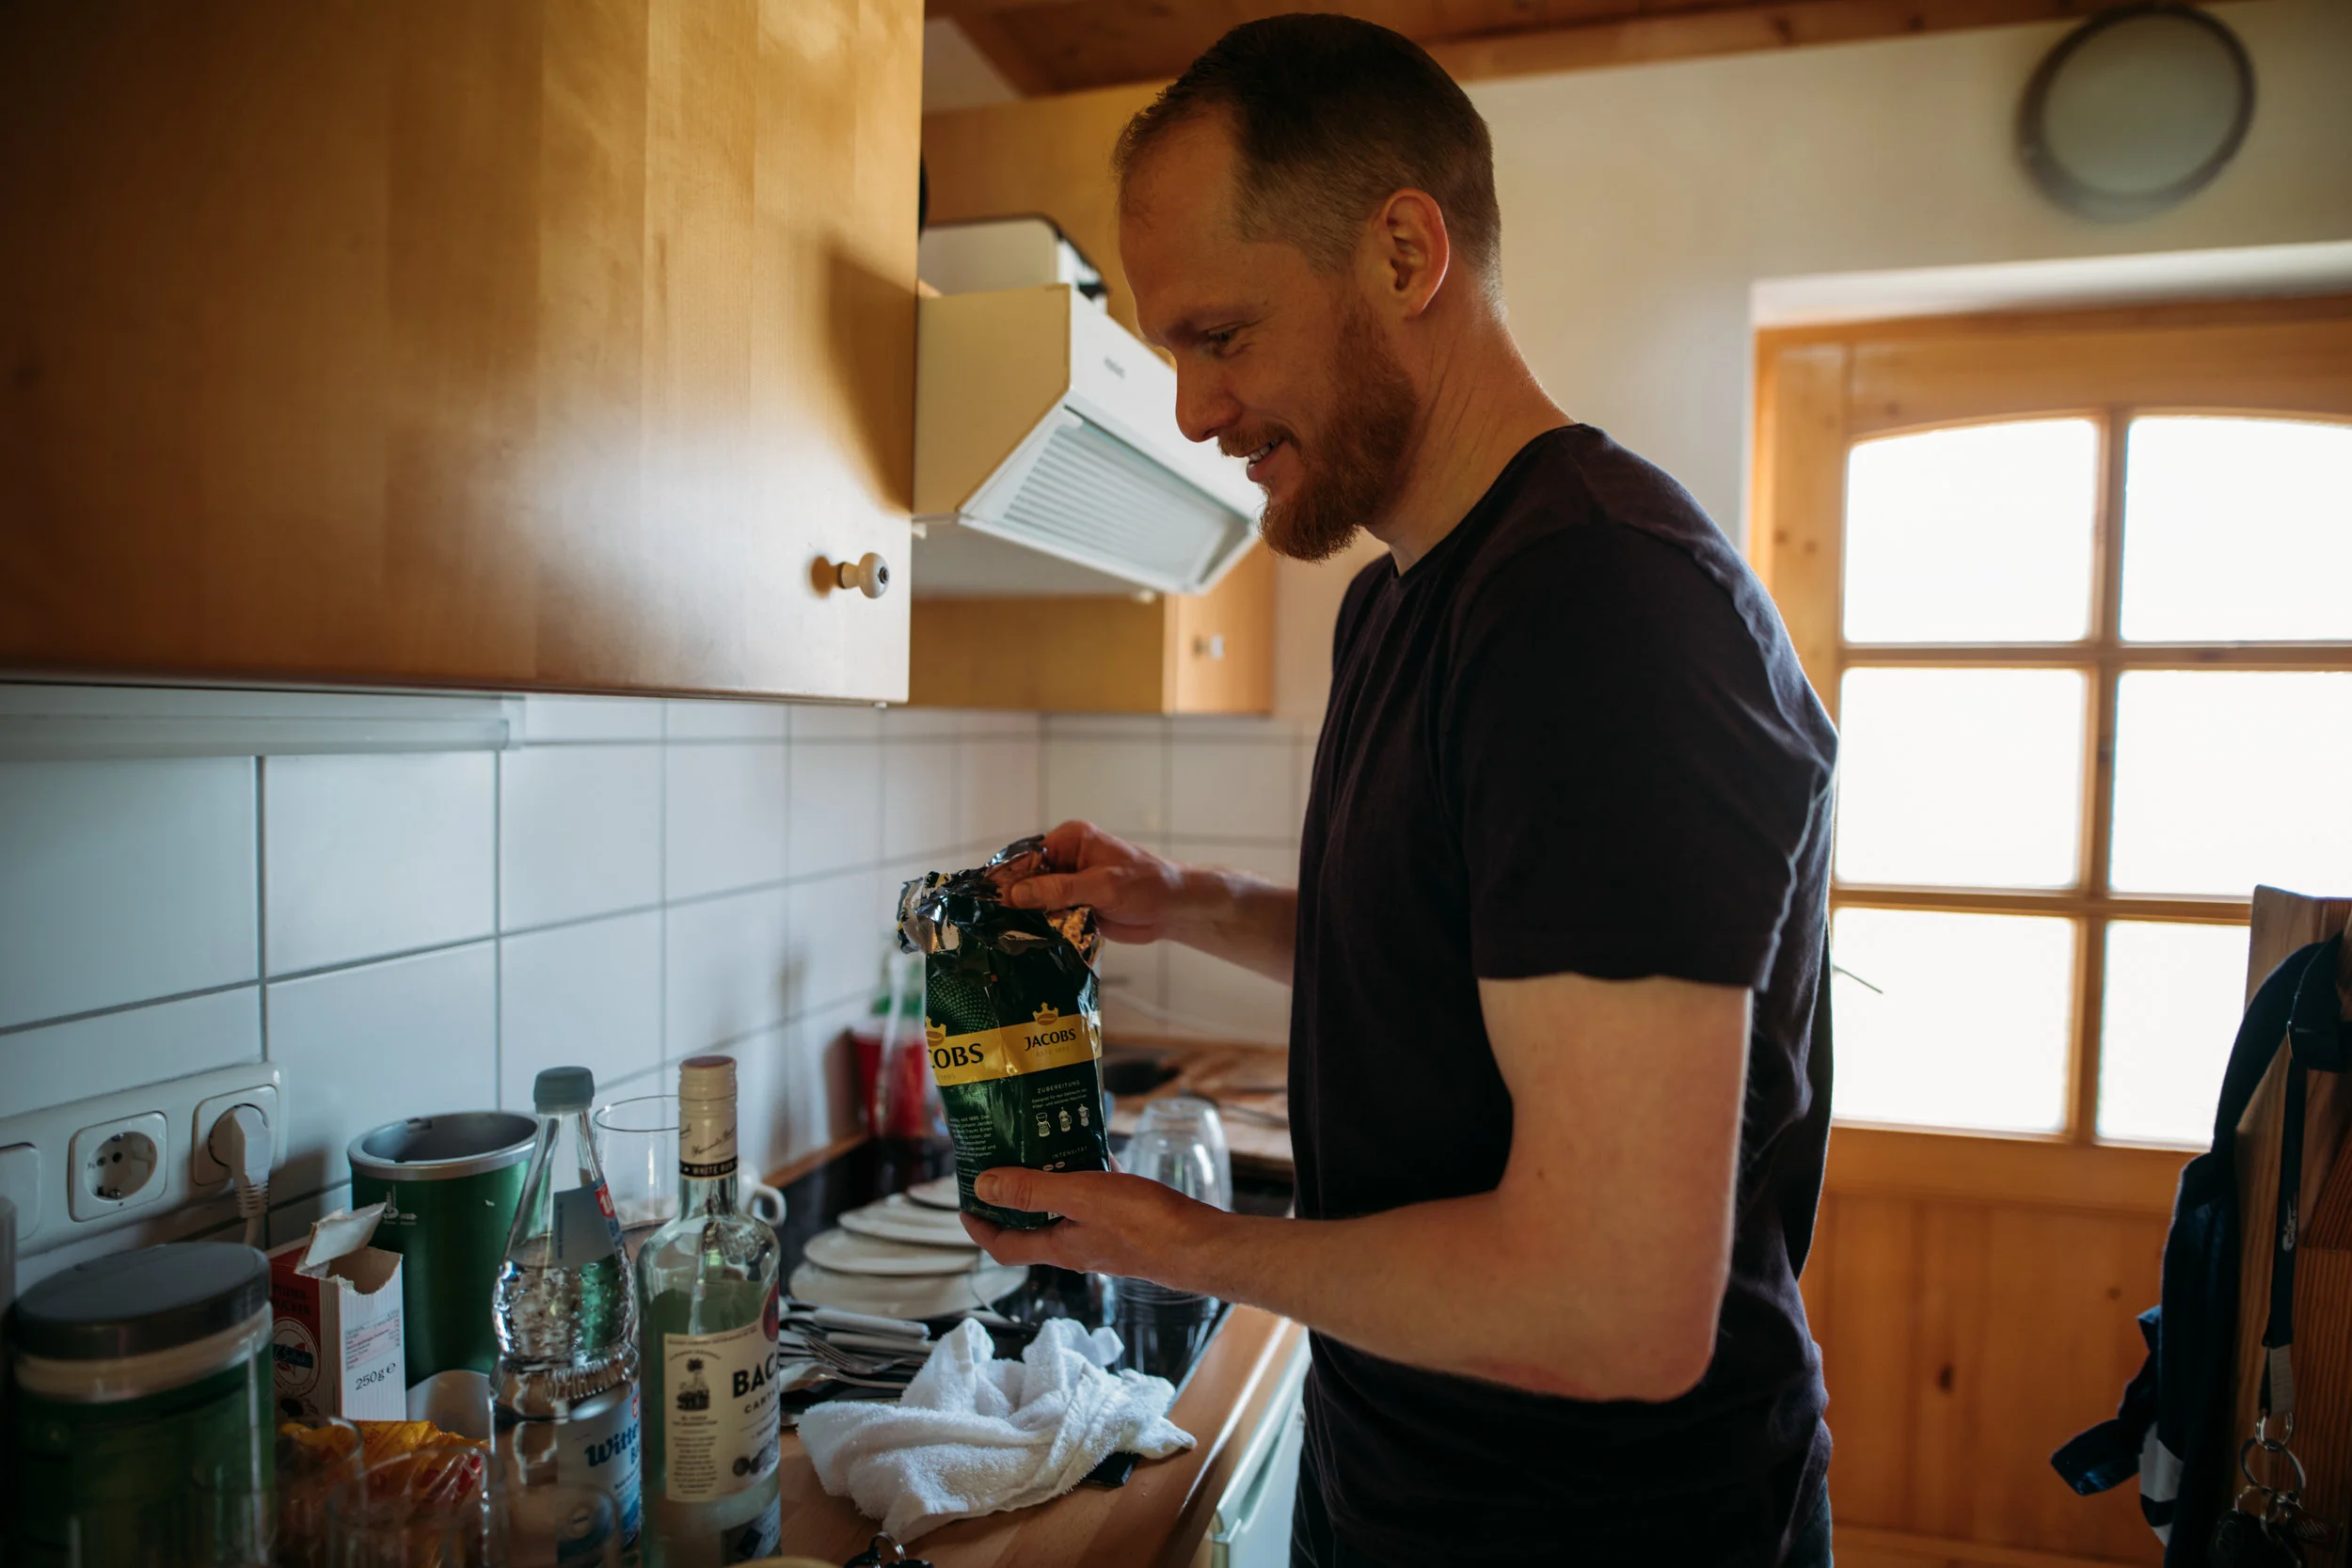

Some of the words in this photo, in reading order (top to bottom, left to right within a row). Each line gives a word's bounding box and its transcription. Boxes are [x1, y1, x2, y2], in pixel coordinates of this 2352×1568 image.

[1023, 1027, 1076, 1052] JACOBS
[1036, 1079, 1081, 1094] ZUBEREITUNG
[355, 1367, 386, 1391] 250g
[732, 1351, 779, 1400] BAC
